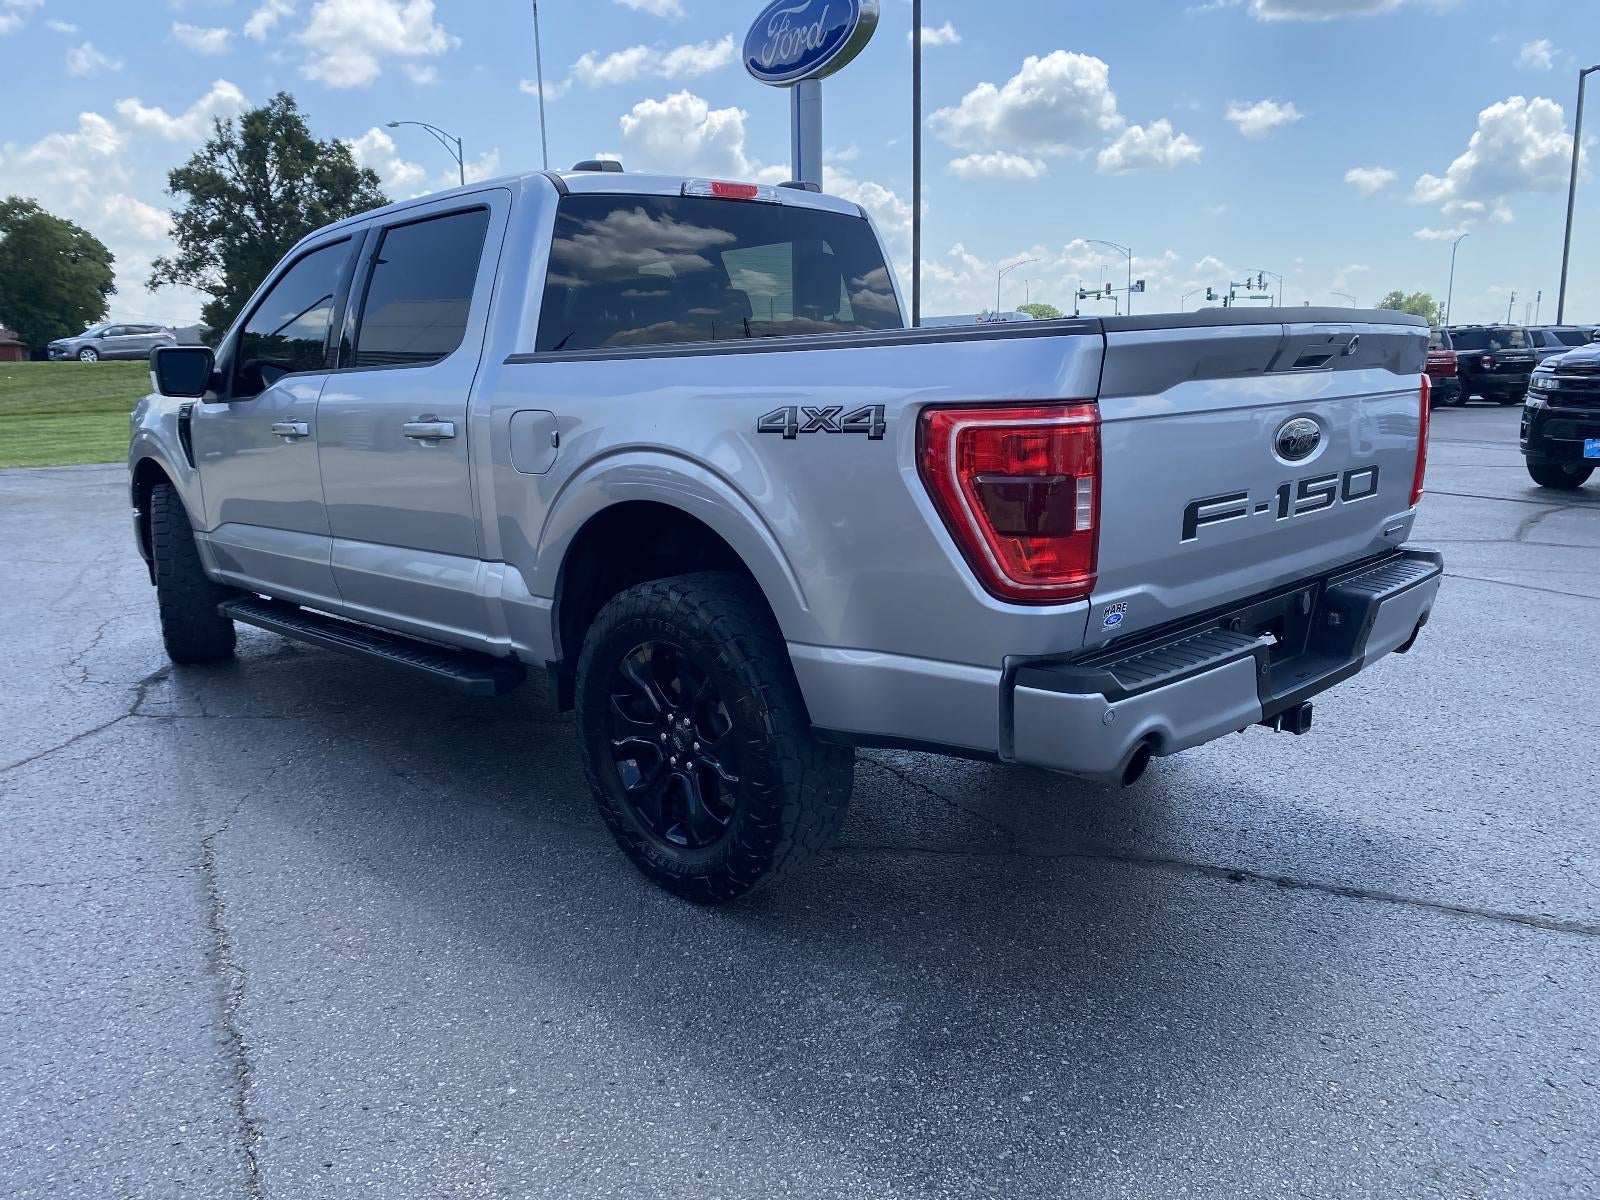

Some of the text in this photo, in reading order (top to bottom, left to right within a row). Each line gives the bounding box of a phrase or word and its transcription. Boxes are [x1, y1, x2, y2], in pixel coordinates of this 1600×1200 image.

[761, 0, 830, 68] Ford
[1179, 464, 1380, 544] F-150
[1103, 602, 1127, 618] HARE
